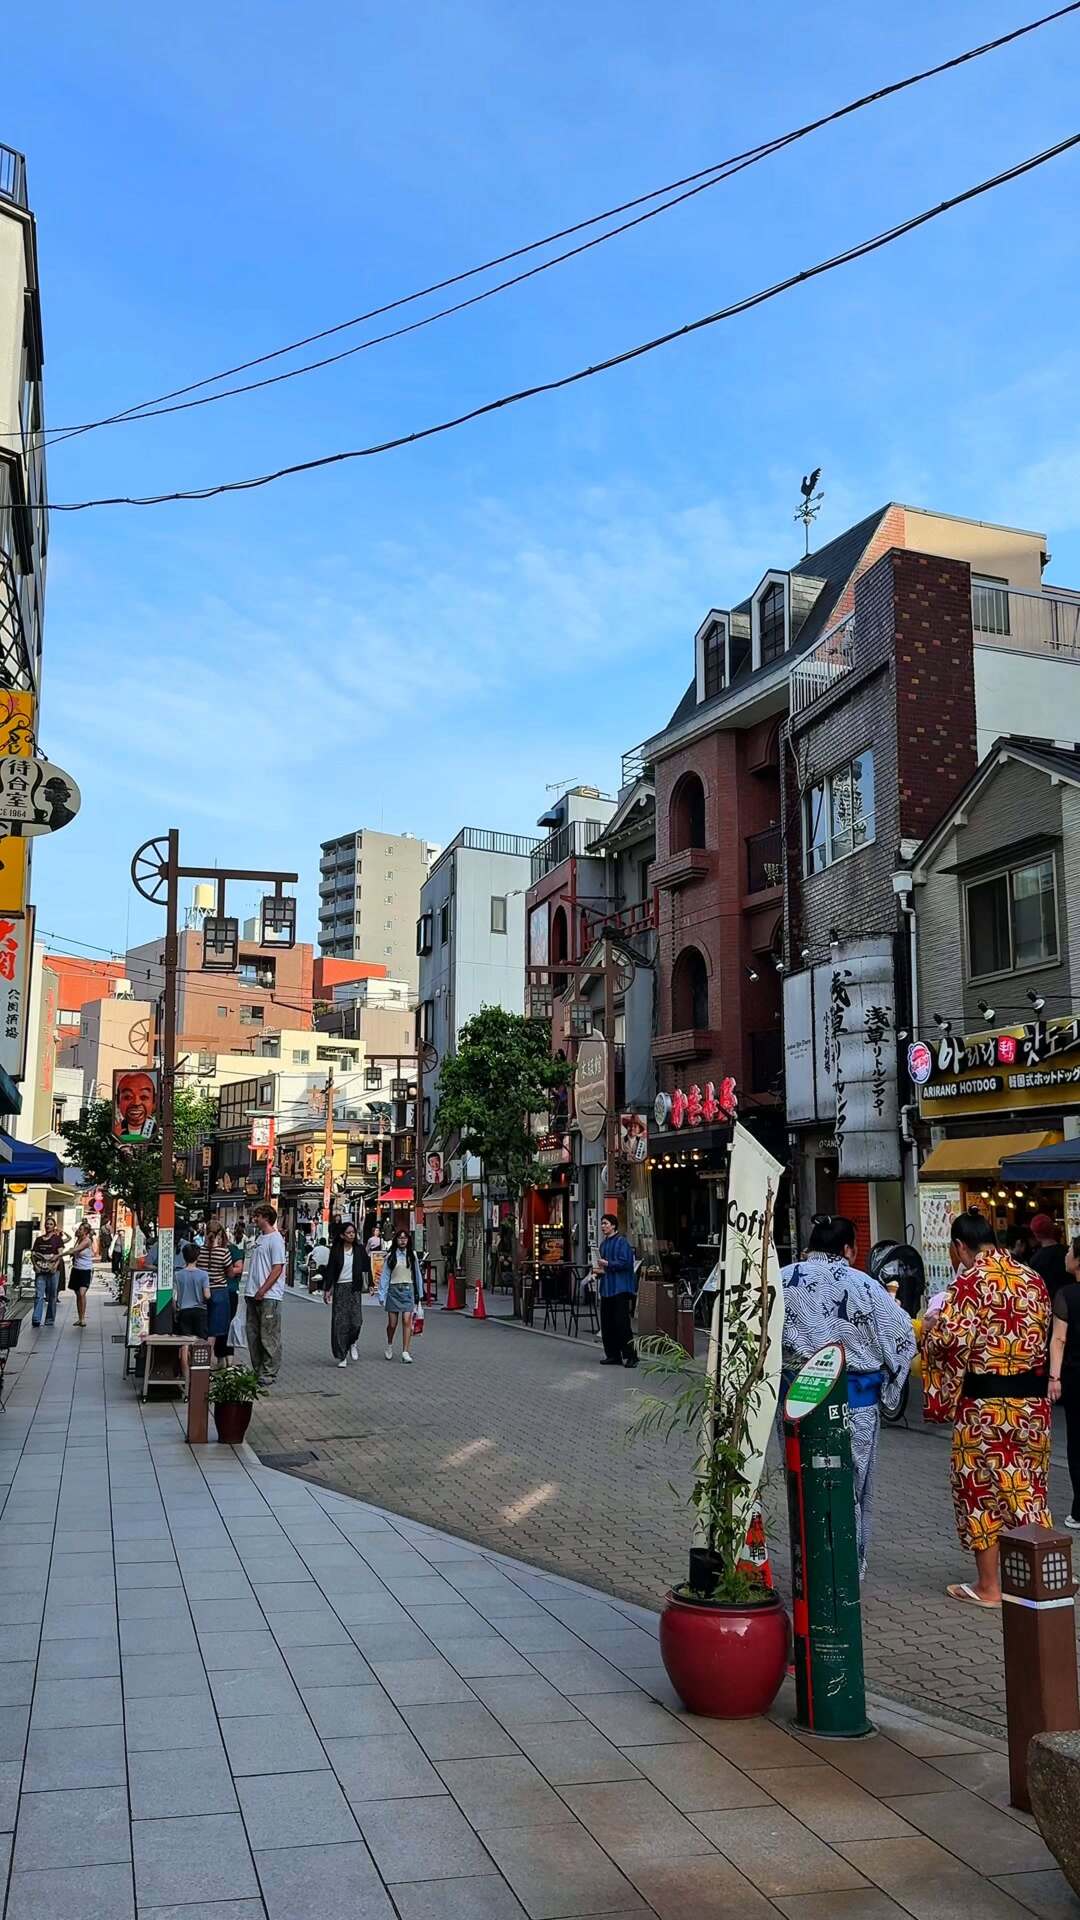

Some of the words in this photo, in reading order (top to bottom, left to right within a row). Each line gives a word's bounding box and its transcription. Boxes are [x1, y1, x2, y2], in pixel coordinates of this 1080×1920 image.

[6, 760, 31, 808] 待合室
[9, 809, 27, 818] 1964
[863, 1005, 893, 1117] 浅草リトルシアター
[937, 1037, 996, 1075] 아리랑
[922, 1083, 958, 1099] ARIRANG
[959, 1077, 997, 1094] HOTDOG
